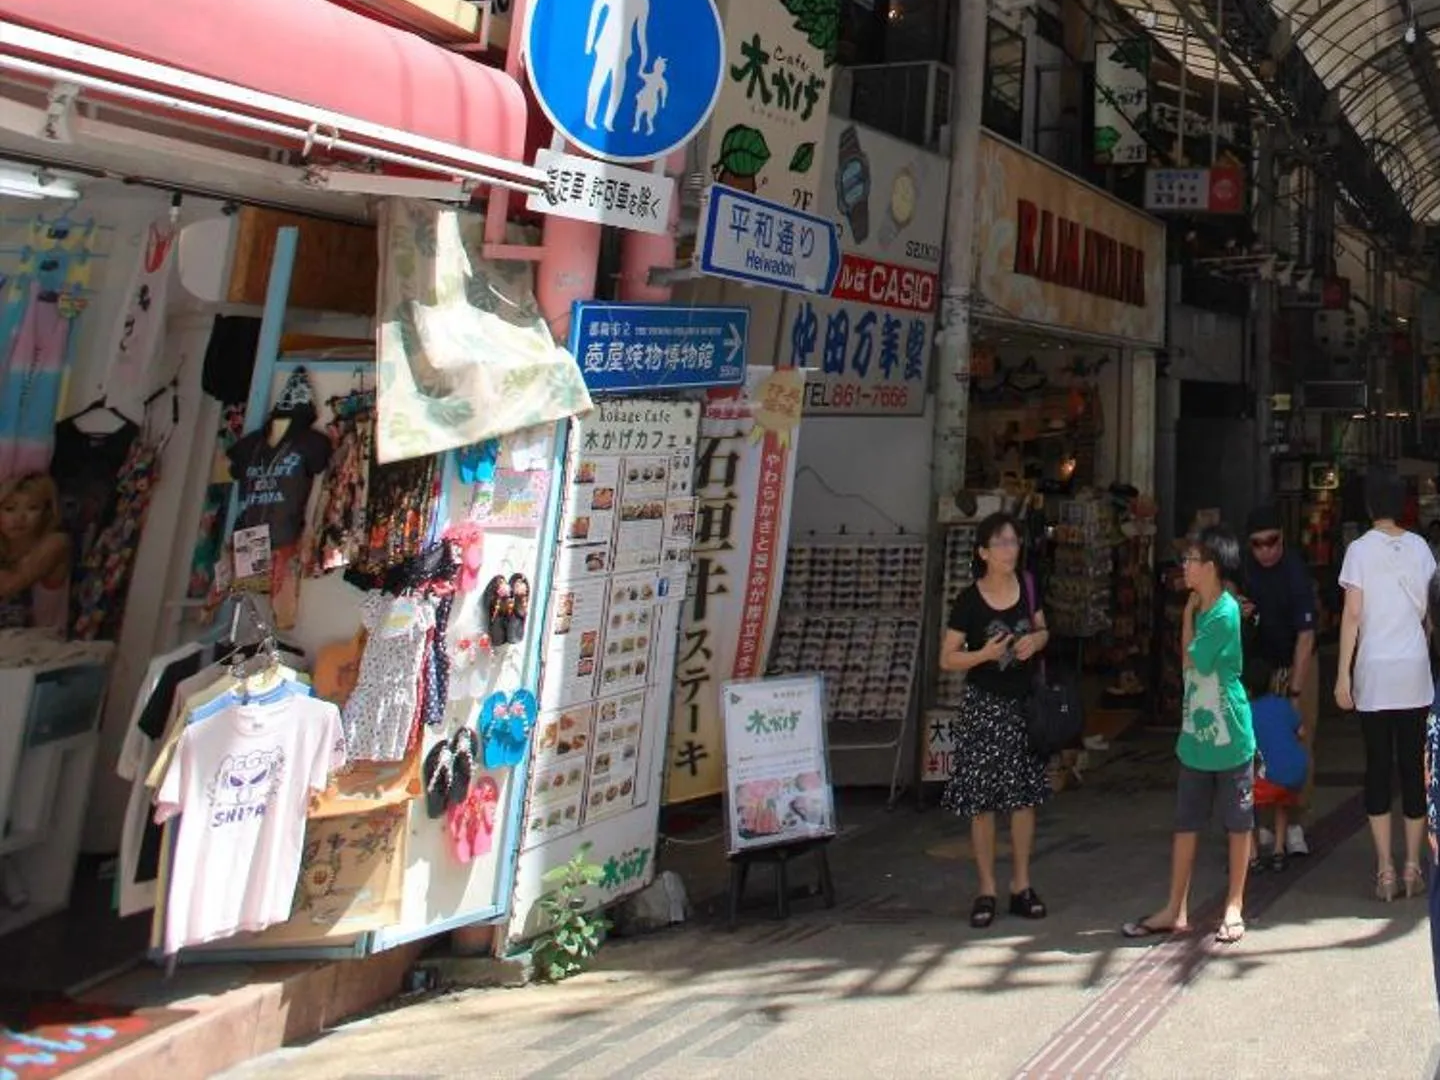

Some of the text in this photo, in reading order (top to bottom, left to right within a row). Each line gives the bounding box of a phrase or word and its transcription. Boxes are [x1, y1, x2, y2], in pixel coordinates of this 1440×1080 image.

[731, 33, 825, 121] 木かげ
[730, 204, 815, 259] 平和通り
[746, 249, 796, 278] Heiwadori
[869, 265, 932, 309] CASIO
[584, 428, 678, 451] 木かげカフェ
